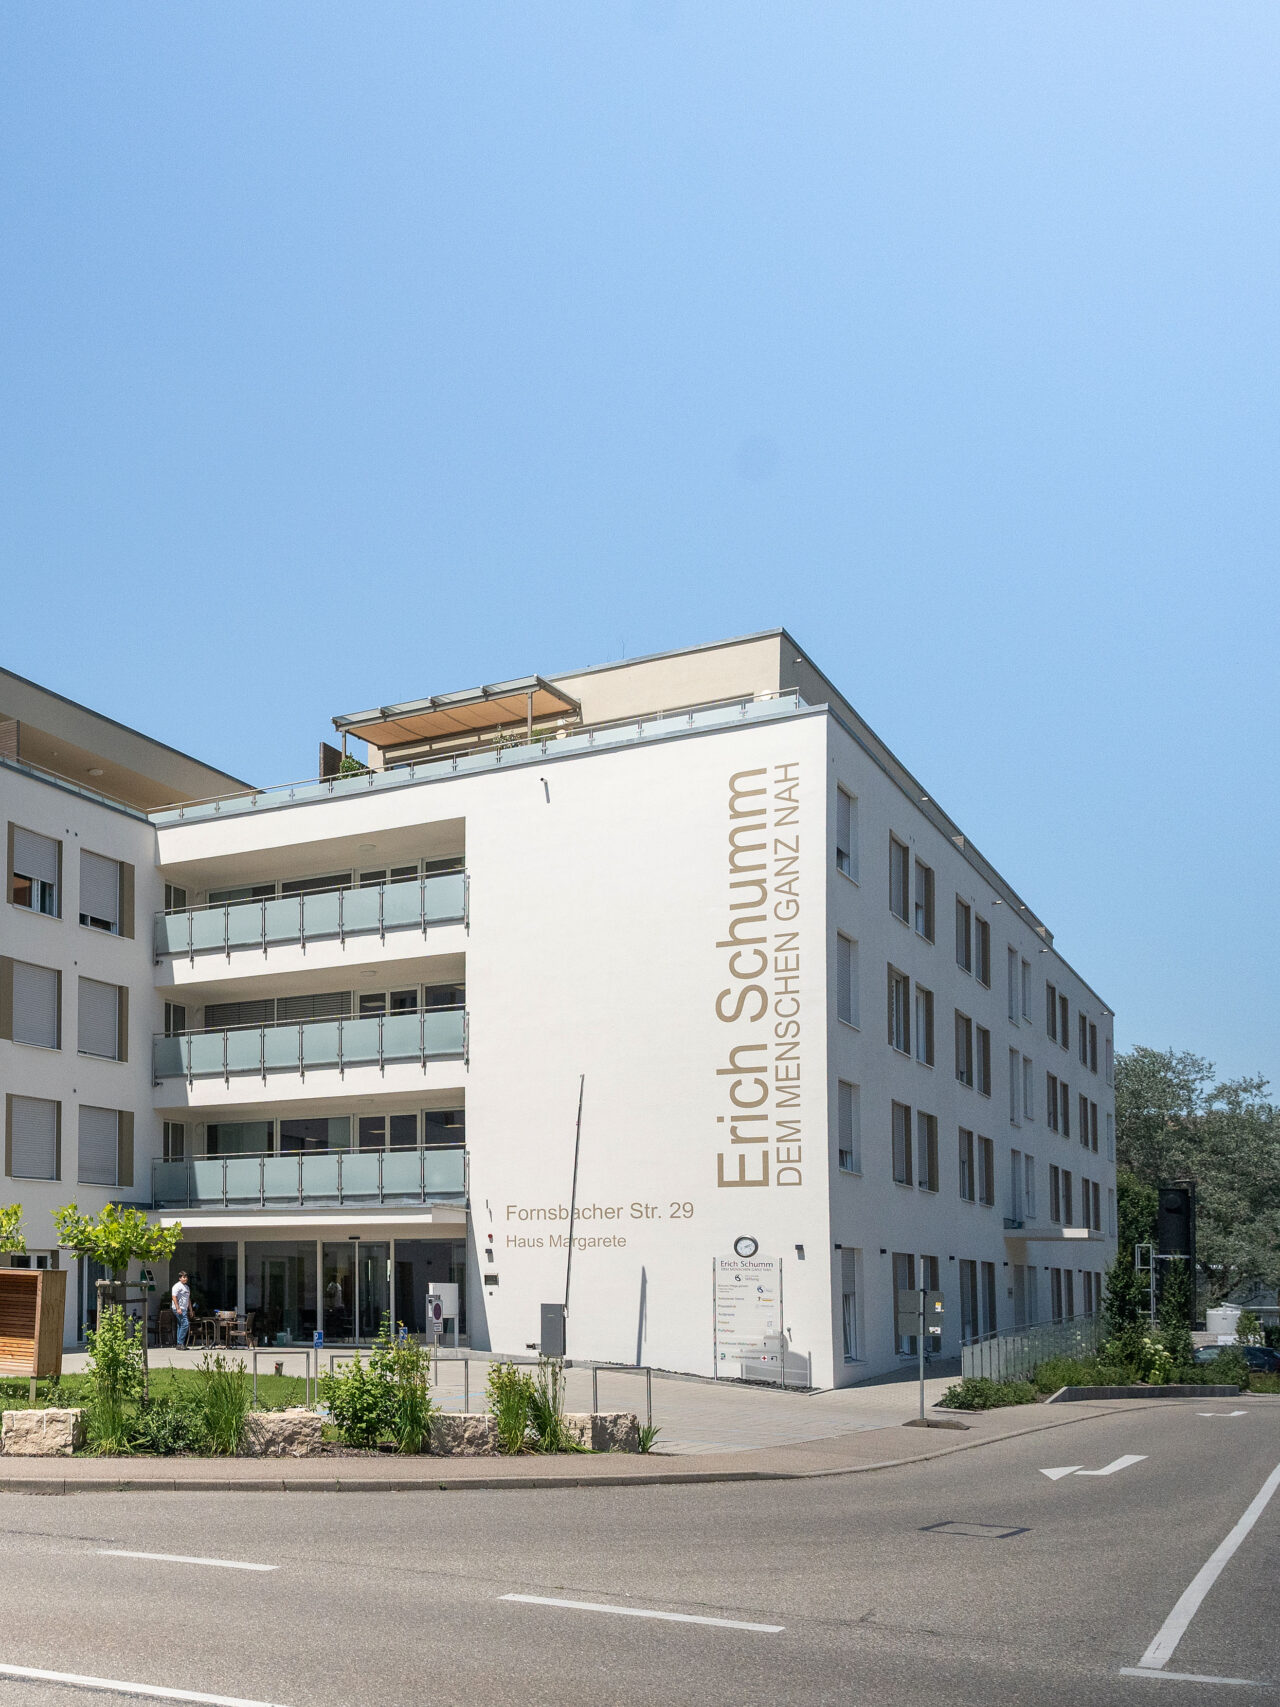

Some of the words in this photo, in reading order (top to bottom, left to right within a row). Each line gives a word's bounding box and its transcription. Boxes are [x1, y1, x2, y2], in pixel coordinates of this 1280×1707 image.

[774, 761, 800, 827] NAH
[715, 767, 768, 1023] Schumm
[774, 834, 800, 921] GANZ
[774, 932, 801, 1107] MENSCHEN
[715, 1043, 769, 1188] Erich
[776, 1119, 802, 1187] DEM
[506, 1203, 623, 1221] Fornsbacher
[630, 1202, 662, 1219] Str.
[669, 1201, 694, 1219] 29
[506, 1234, 544, 1248] Haus
[549, 1234, 627, 1251] Margarete
[720, 1260, 738, 1268] Erich
[740, 1260, 774, 1268] Schumm
